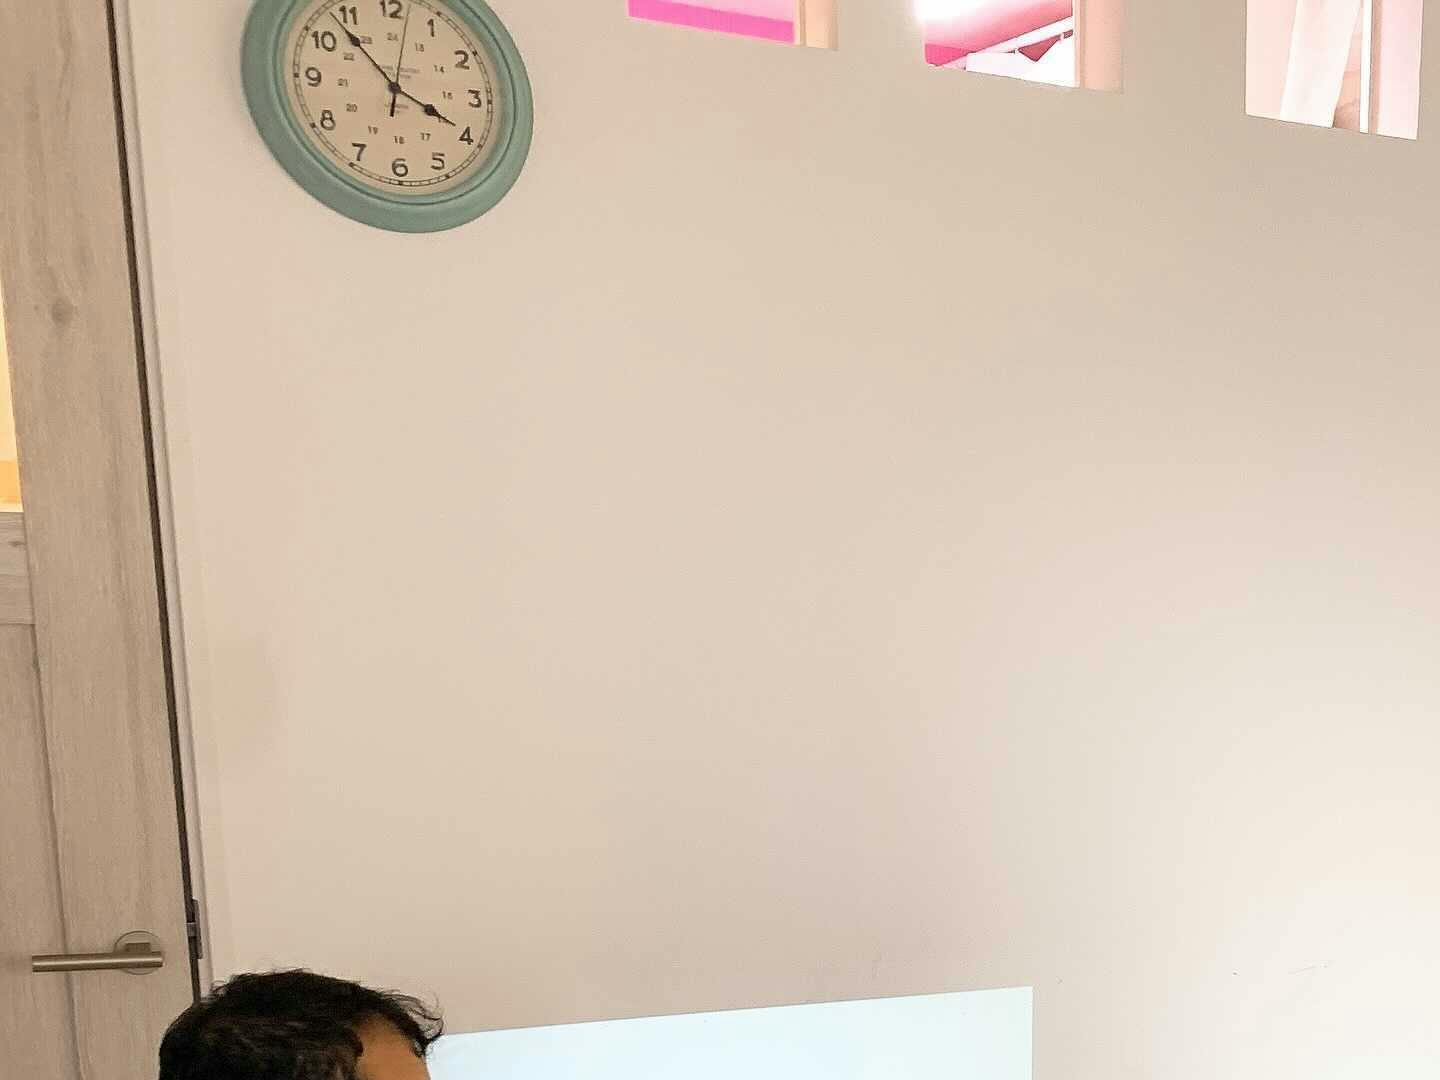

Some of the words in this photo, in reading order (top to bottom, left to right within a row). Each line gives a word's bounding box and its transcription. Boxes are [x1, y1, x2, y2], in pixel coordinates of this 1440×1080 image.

[339, 6, 359, 25] 11
[380, 0, 403, 19] 12
[427, 19, 435, 37] 1
[312, 31, 336, 52] 10
[454, 50, 470, 70] 2
[304, 67, 322, 87] 9
[468, 89, 482, 108] 3
[320, 110, 336, 131] 8
[420, 132, 431, 142] 17
[459, 126, 474, 146] 4
[352, 143, 367, 162] 7
[431, 153, 446, 171] 5
[391, 158, 408, 178] 6
